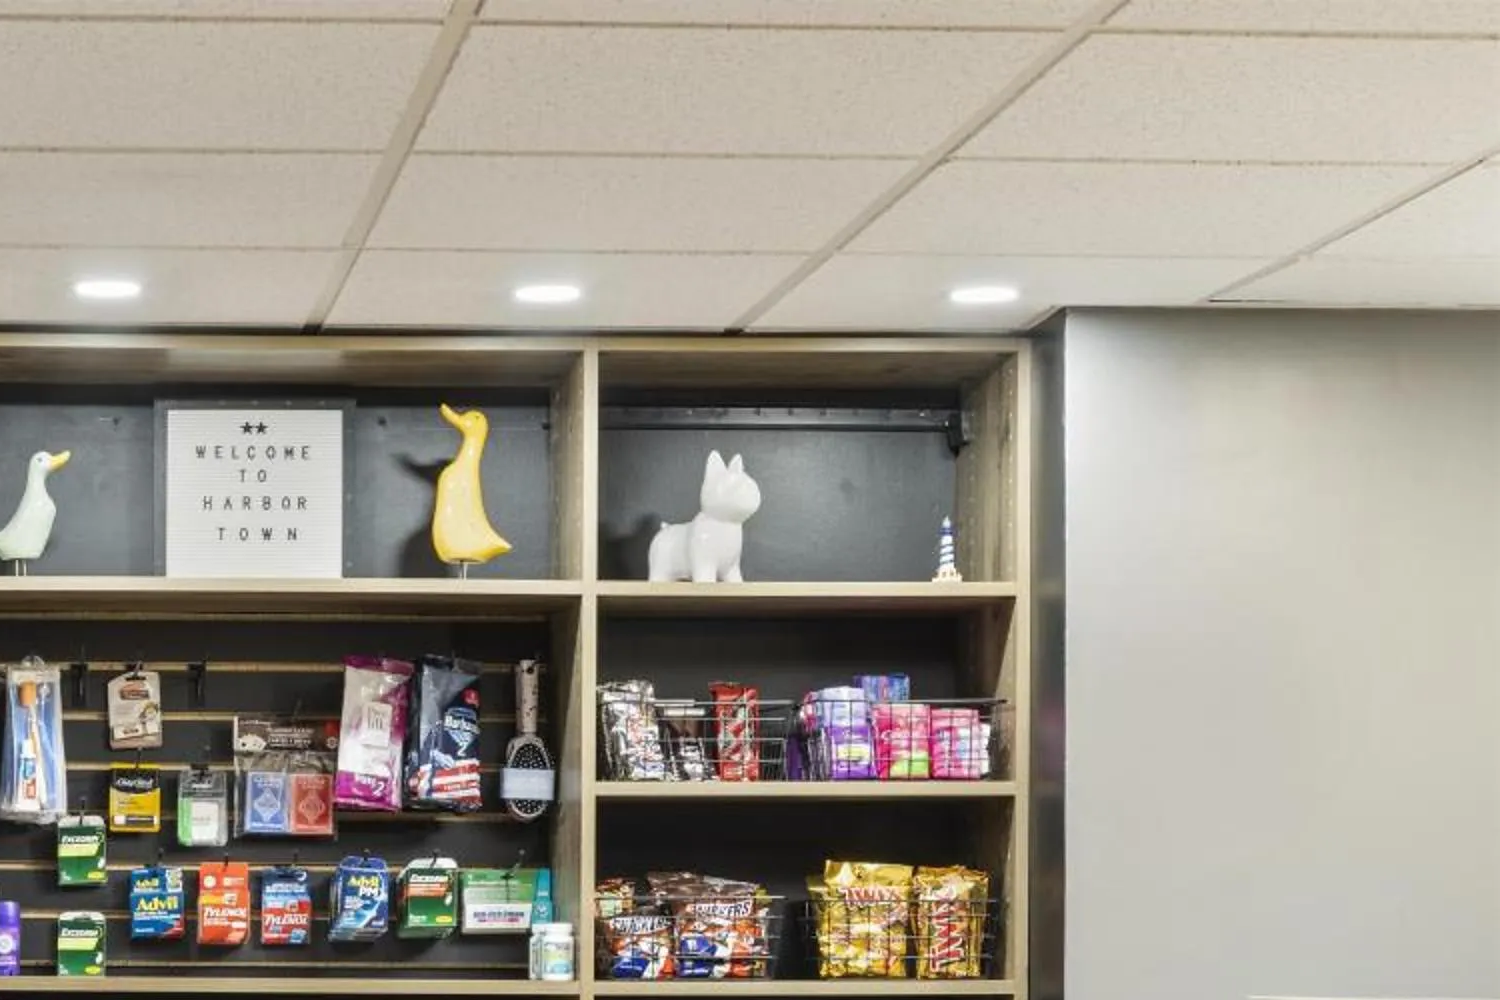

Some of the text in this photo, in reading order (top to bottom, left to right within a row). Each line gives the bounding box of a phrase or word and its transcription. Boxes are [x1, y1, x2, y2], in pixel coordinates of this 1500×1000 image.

[195, 445, 311, 461] WELCOME
[239, 469, 268, 483] TO
[202, 495, 308, 510] HARBOR
[217, 527, 298, 541] TOWN
[136, 894, 180, 911] Advil
